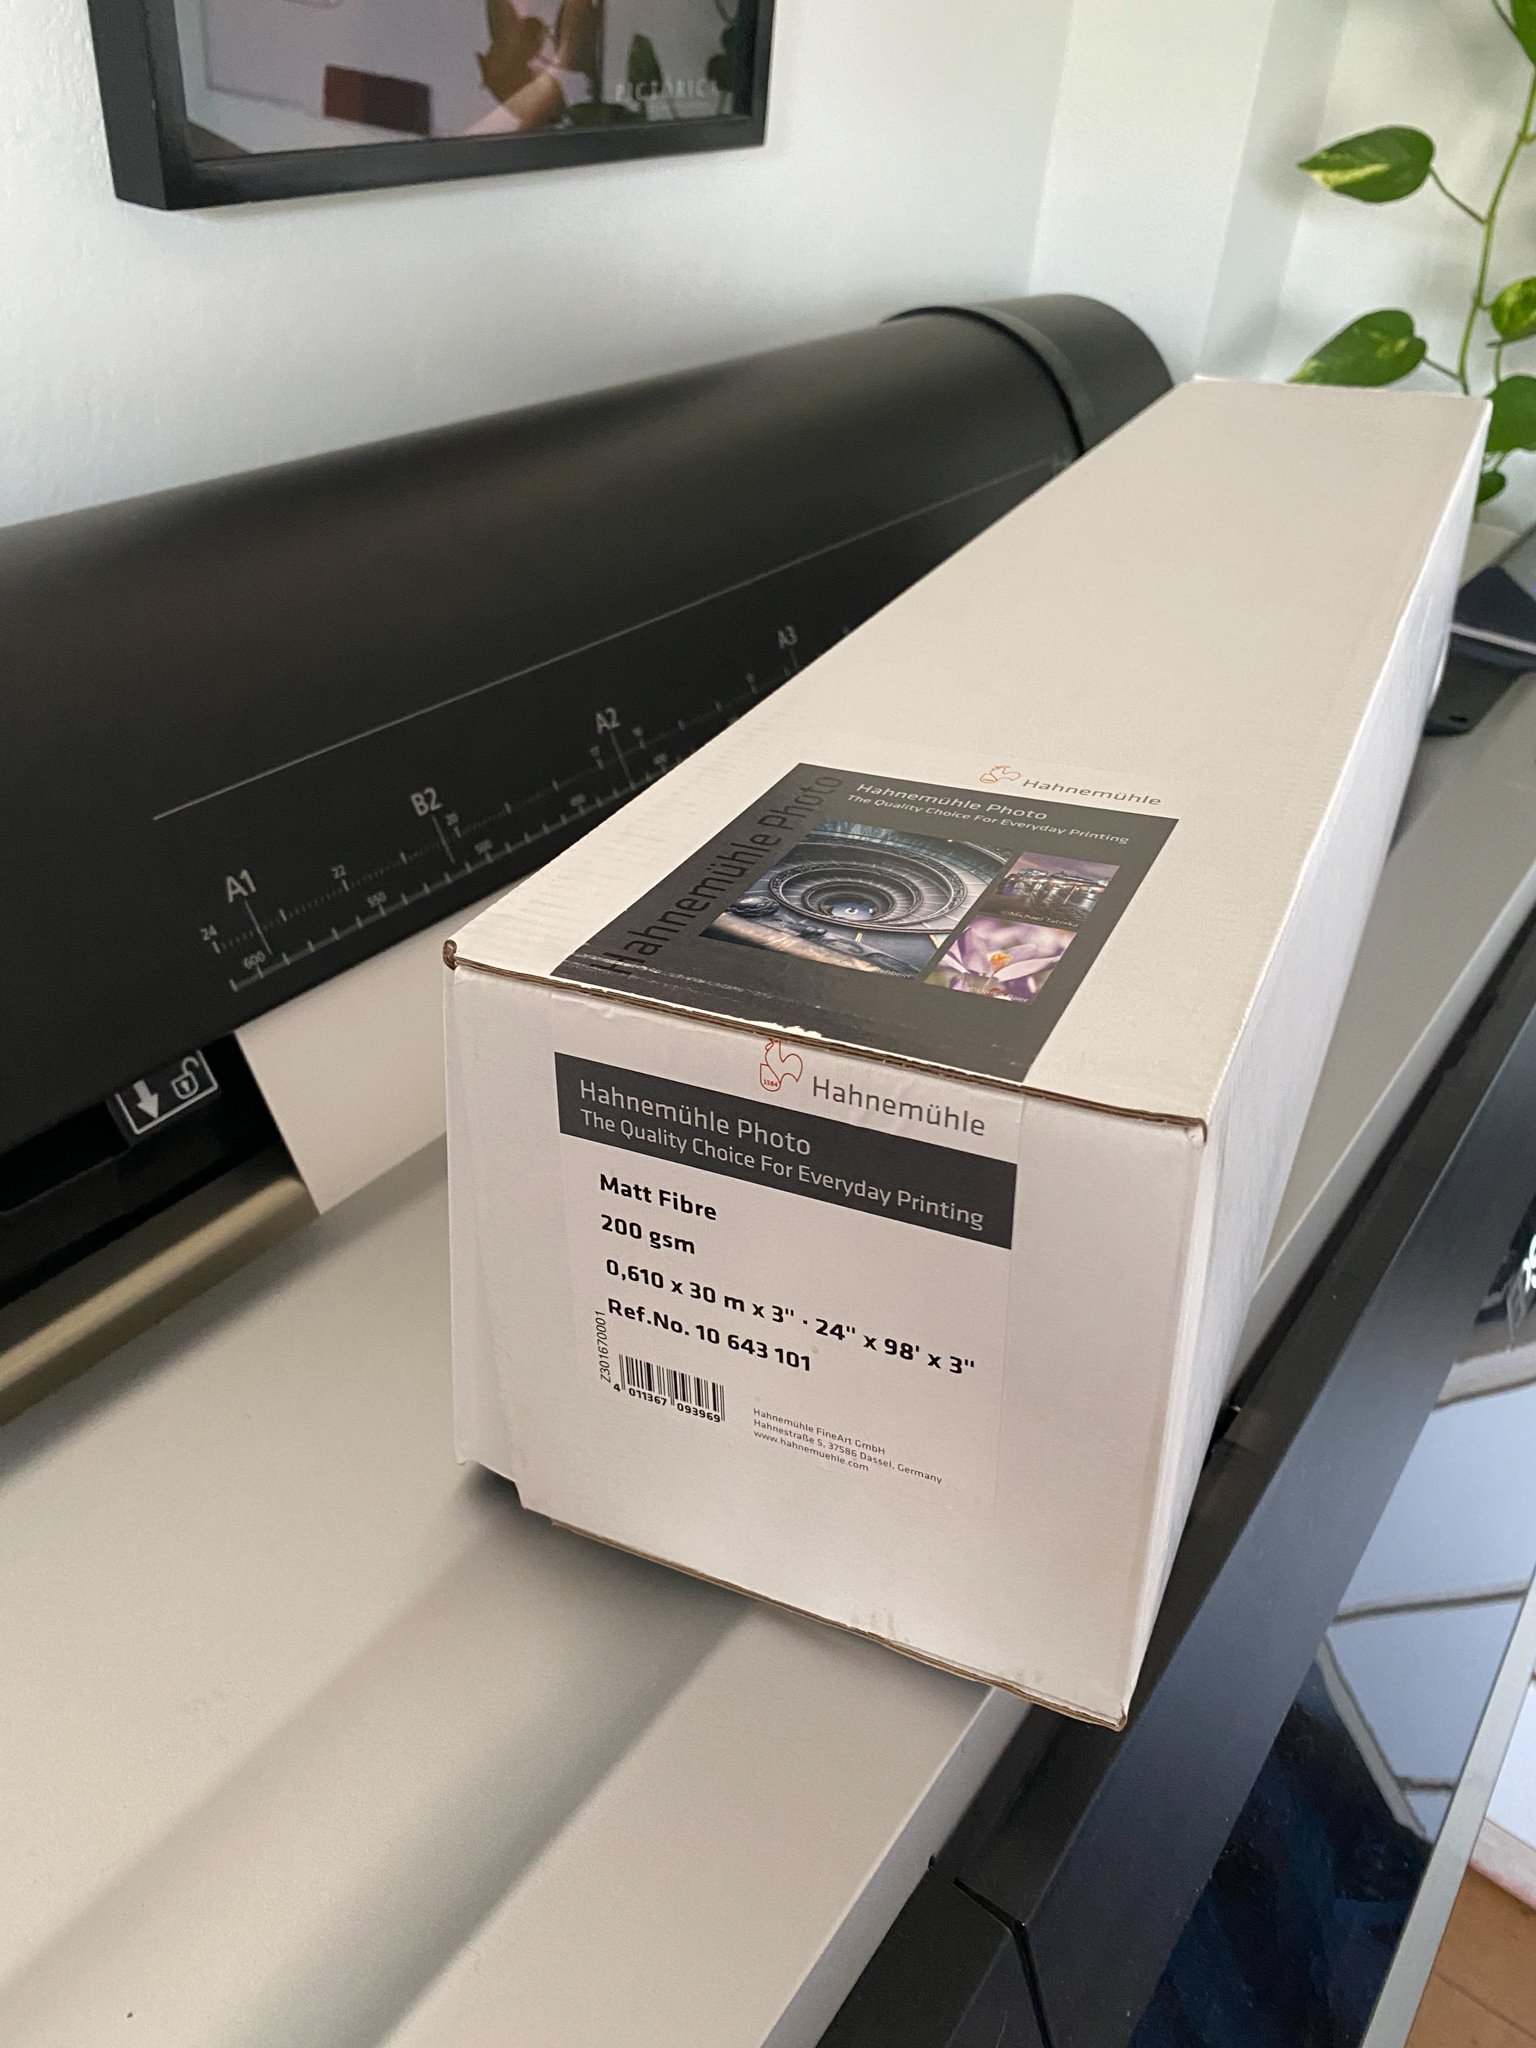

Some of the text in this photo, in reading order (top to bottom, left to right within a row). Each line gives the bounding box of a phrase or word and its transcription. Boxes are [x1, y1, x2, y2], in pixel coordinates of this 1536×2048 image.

[595, 707, 621, 734] A2
[410, 787, 442, 817] B2
[856, 783, 1048, 821] Hahnemühle Photo
[1022, 778, 1163, 807] Hahnemühle
[847, 793, 1129, 845] The Quality Choice For Everyday Printing
[226, 869, 257, 903] A1
[331, 864, 347, 880] 22
[590, 776, 843, 976] Hahnemühle Photo
[201, 924, 217, 942] 24
[580, 1079, 811, 1156] Hahnemühle Photo
[812, 1075, 986, 1137] Hahnemühle
[580, 1109, 984, 1231] The Quality Choice For Everyday Printing
[600, 1173, 718, 1221] Matt Fibre
[601, 1214, 696, 1255] 200 gsm
[606, 1258, 664, 1289] 0,610
[671, 1280, 684, 1295] x
[690, 1282, 716, 1303] 30
[724, 1295, 745, 1313] m
[752, 1302, 766, 1318] x
[863, 1335, 877, 1351] x
[927, 1352, 941, 1369] x
[608, 1298, 811, 1371] Ref.No. 10 643 101
[613, 1383, 721, 1423] 4 011367 093969
[753, 1407, 886, 1455] Hahnemühle FineArt GmbH
[753, 1430, 869, 1472] www.hahnemuehle.com
[753, 1418, 815, 1444] Hahnestraße
[828, 1442, 858, 1458] 37586
[898, 1463, 943, 1485] Germany
